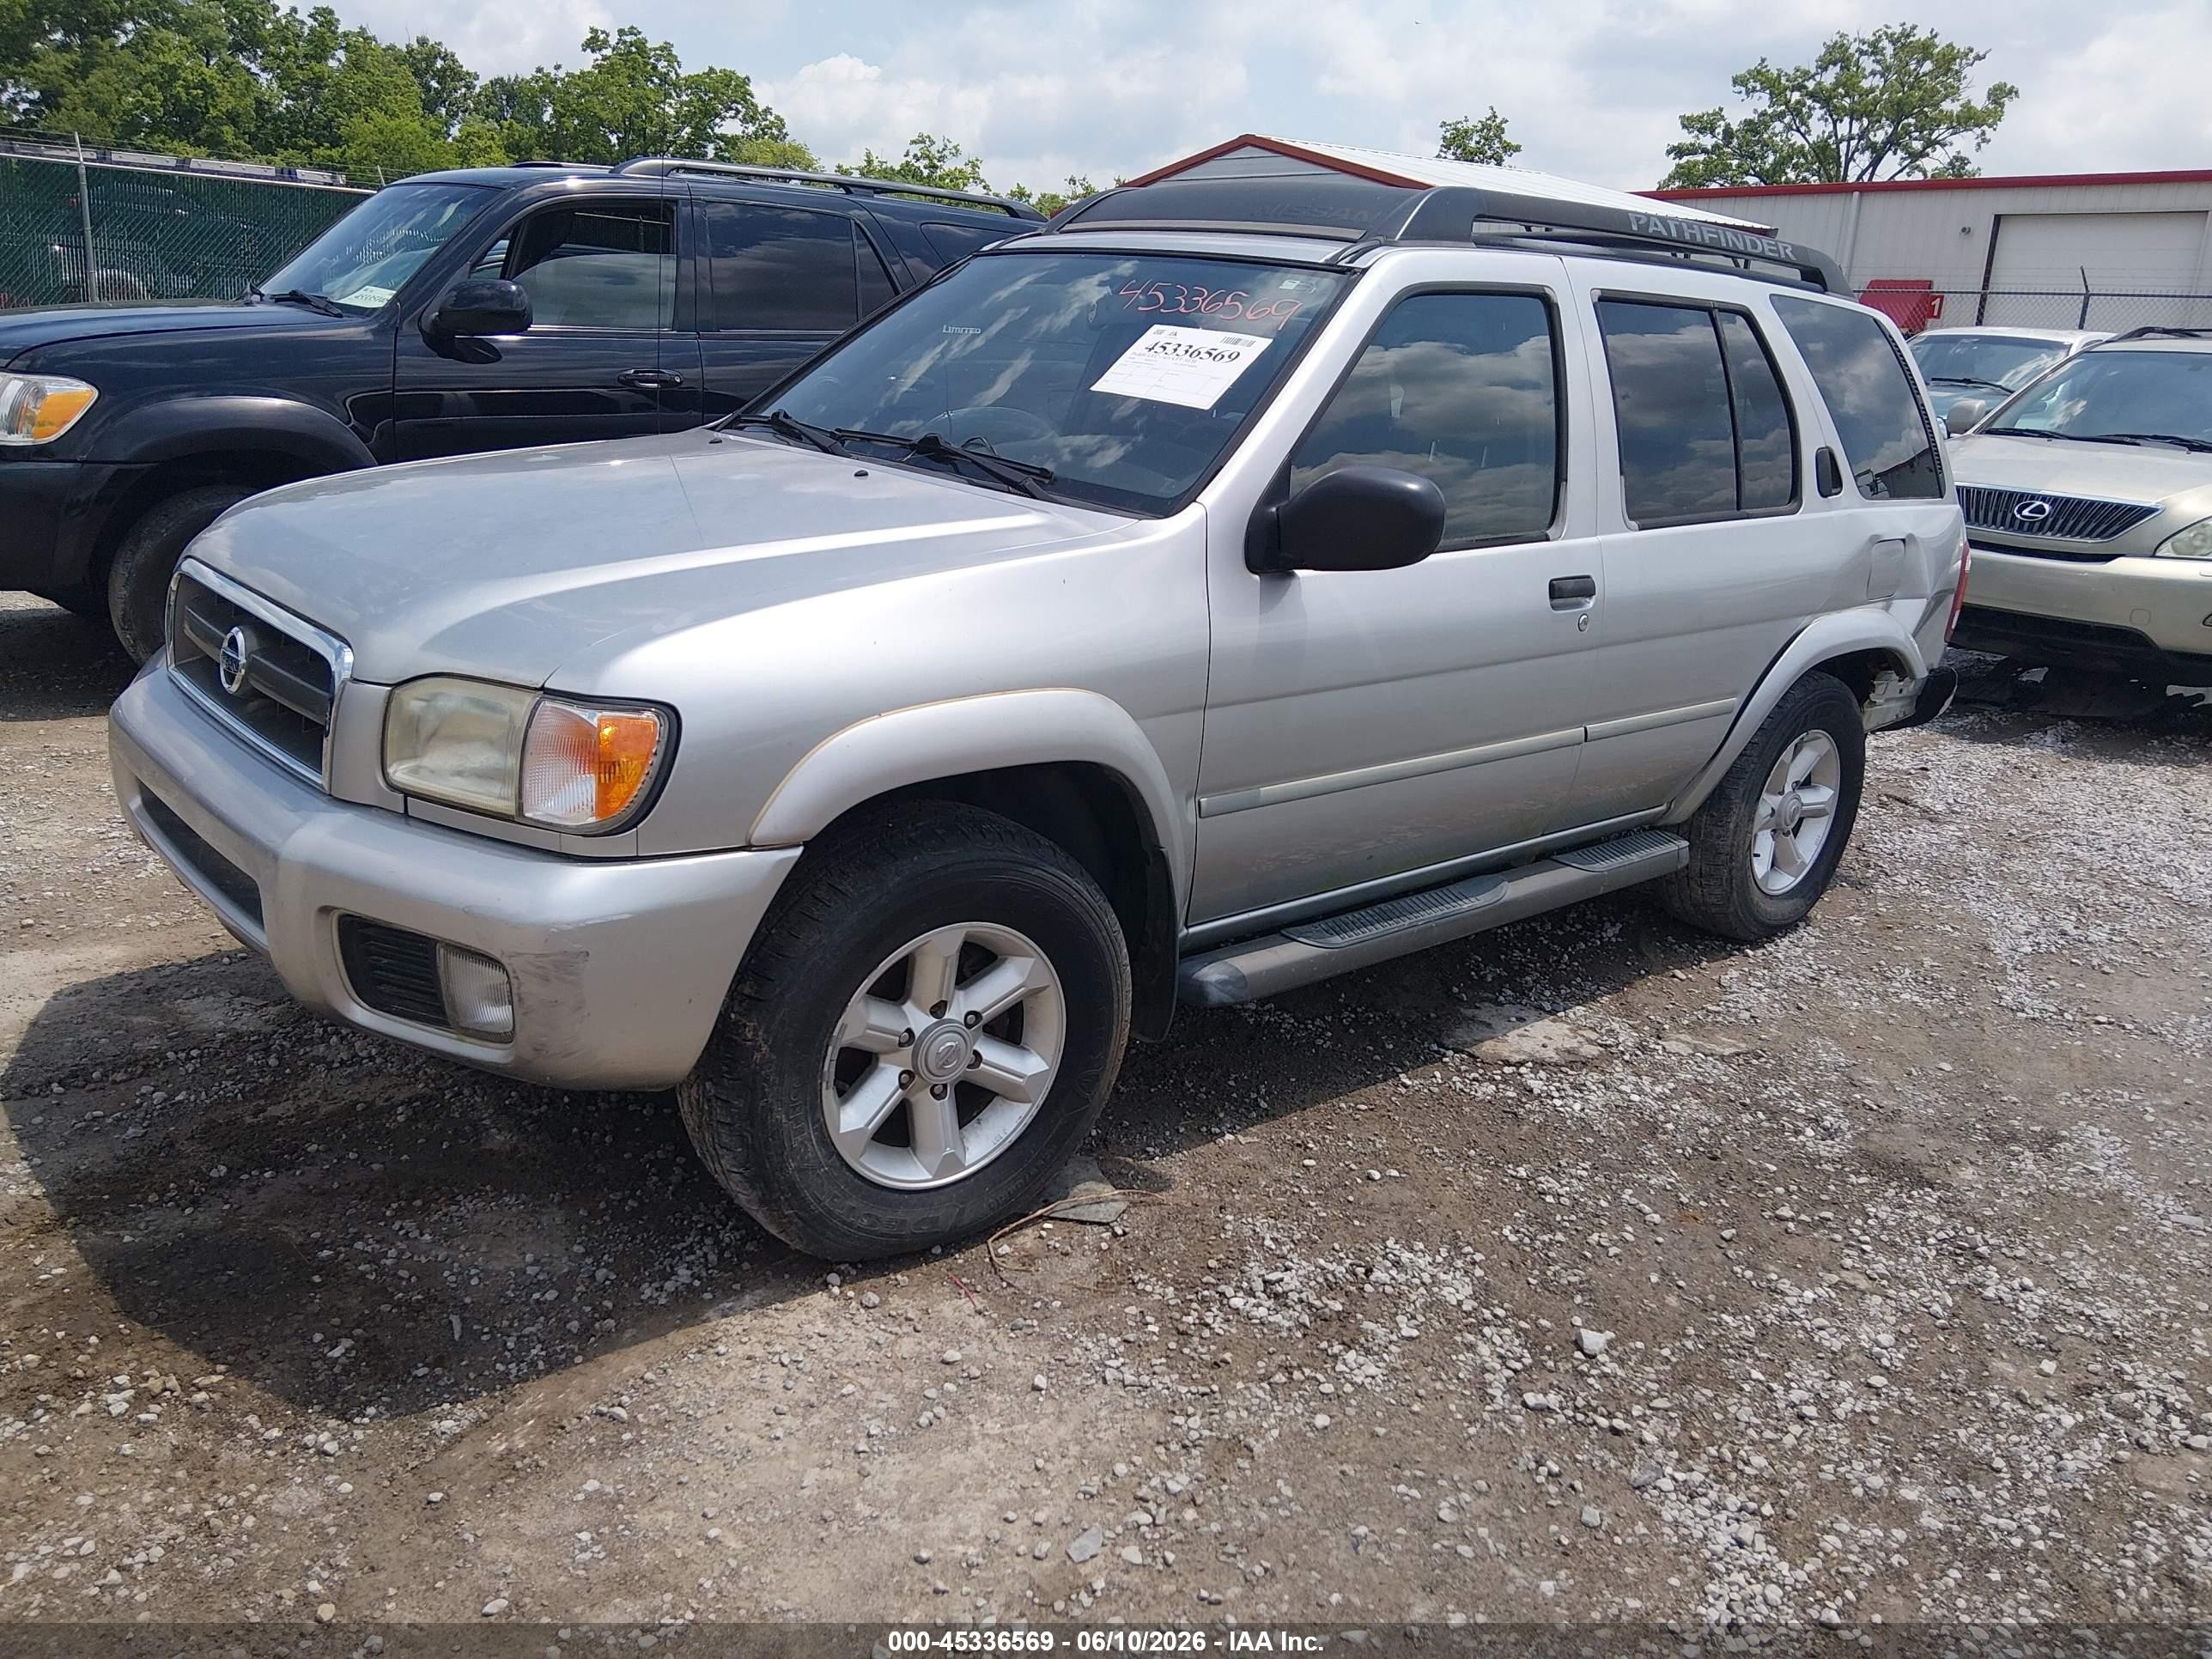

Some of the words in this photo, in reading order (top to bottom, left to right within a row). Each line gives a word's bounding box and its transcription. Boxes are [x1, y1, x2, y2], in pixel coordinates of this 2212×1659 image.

[1627, 212, 1797, 261] PATHFINDER
[1119, 278, 1304, 331] 45336569
[1931, 297, 1941, 316] 1
[1145, 340, 1241, 363] 45336569
